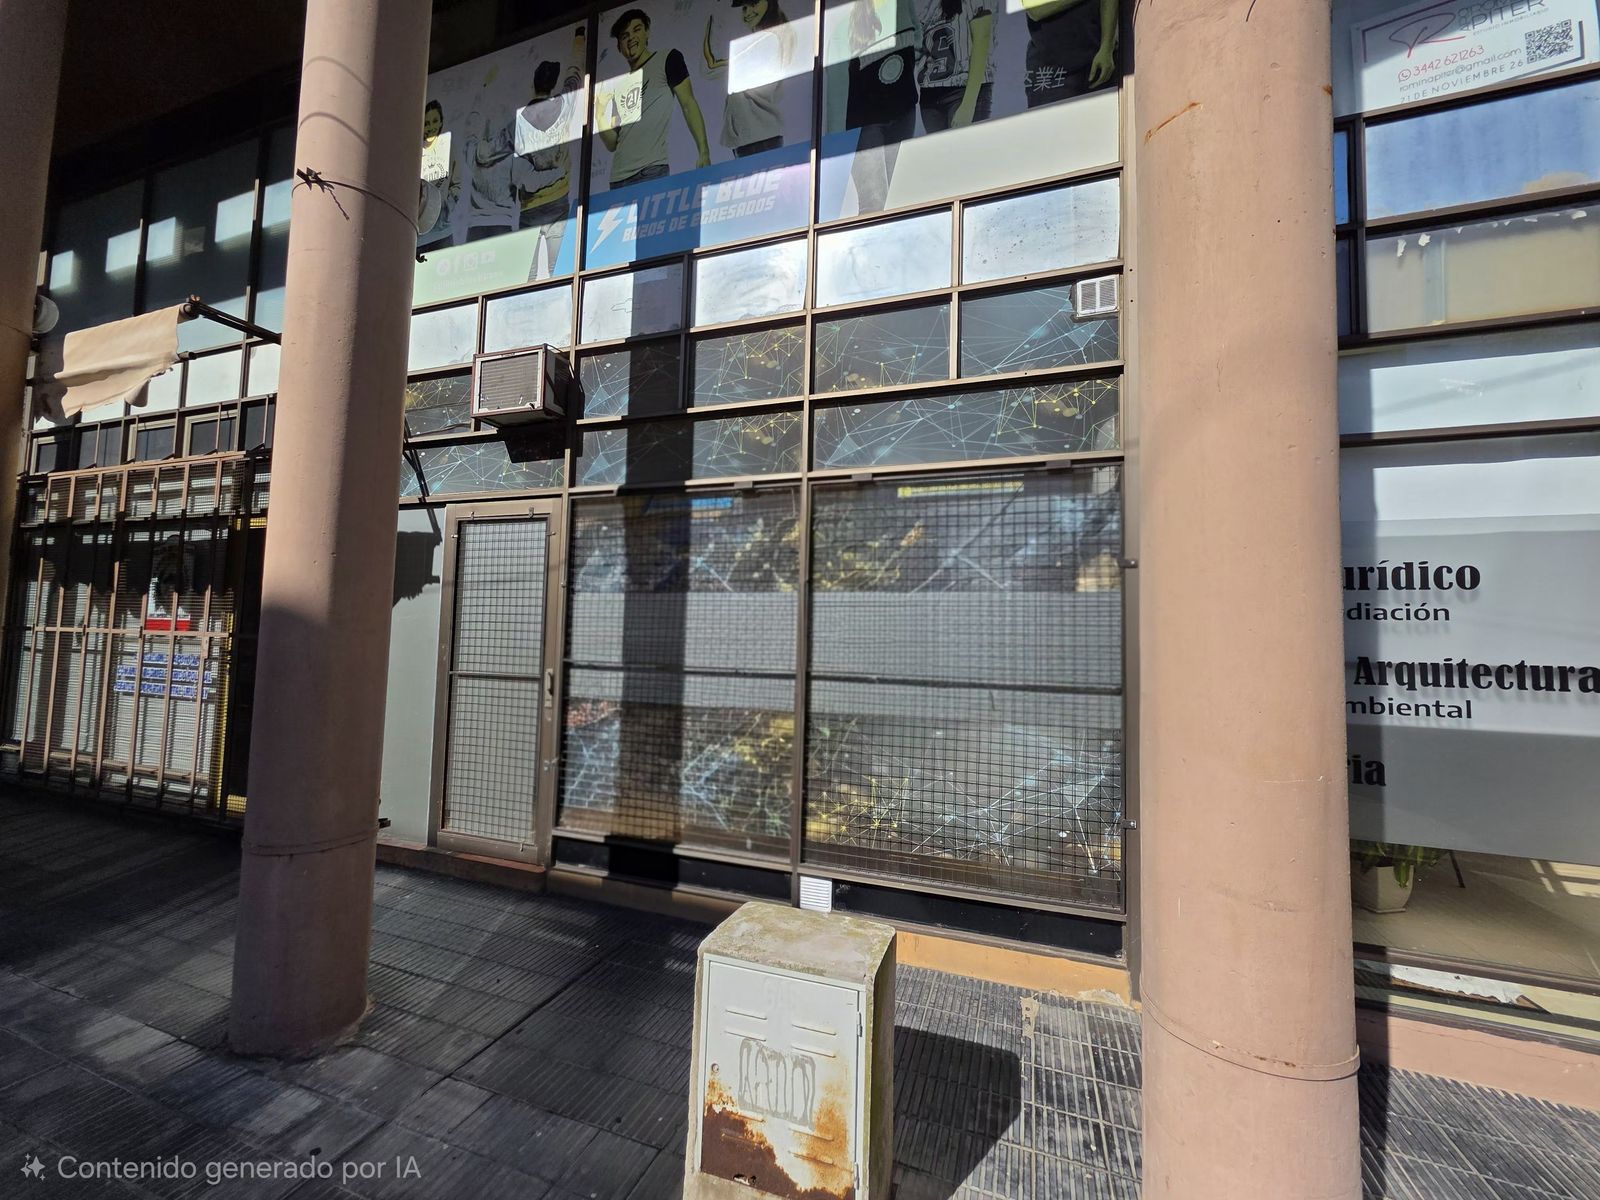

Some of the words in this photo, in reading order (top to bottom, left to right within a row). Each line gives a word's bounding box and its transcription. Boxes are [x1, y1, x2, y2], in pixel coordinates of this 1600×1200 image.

[1399, 48, 1522, 92] rominapiter@gmail.com
[1413, 59, 1441, 77] 3442
[1444, 44, 1485, 66] 621263
[1415, 90, 1428, 100] DE
[1431, 65, 1505, 94] NOVIEMBRE
[1510, 60, 1525, 70] 26
[626, 181, 712, 225] LITTLE
[714, 165, 785, 203] BLUE
[622, 217, 664, 243] BUZOS
[668, 216, 688, 231] DE
[691, 196, 777, 228] EGRESADOS
[1353, 656, 1600, 693] Arquitectura
